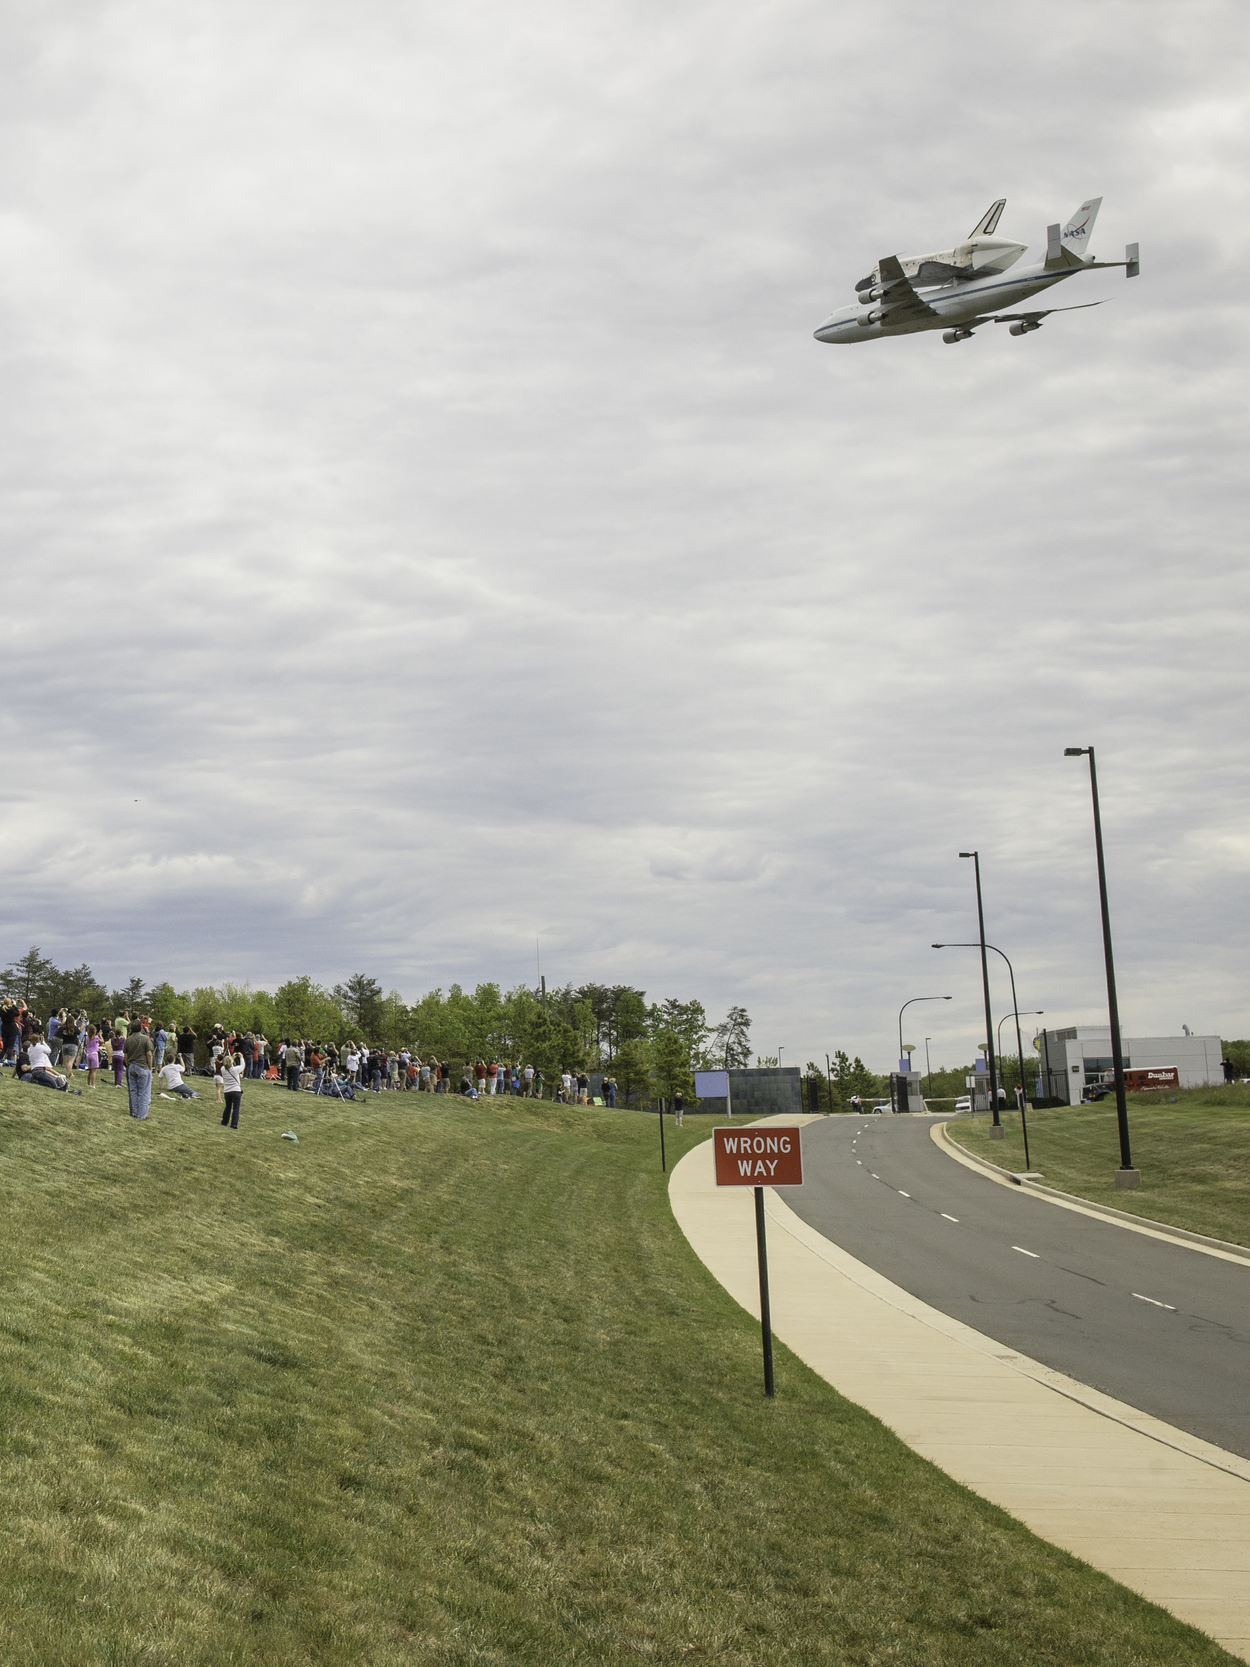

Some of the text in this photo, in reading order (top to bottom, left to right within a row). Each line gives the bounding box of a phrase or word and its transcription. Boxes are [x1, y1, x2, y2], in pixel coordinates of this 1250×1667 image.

[1063, 228, 1086, 238] NASA
[1147, 1071, 1175, 1079] Dunbar
[723, 1136, 791, 1154] WRONG
[737, 1159, 778, 1177] WAY
